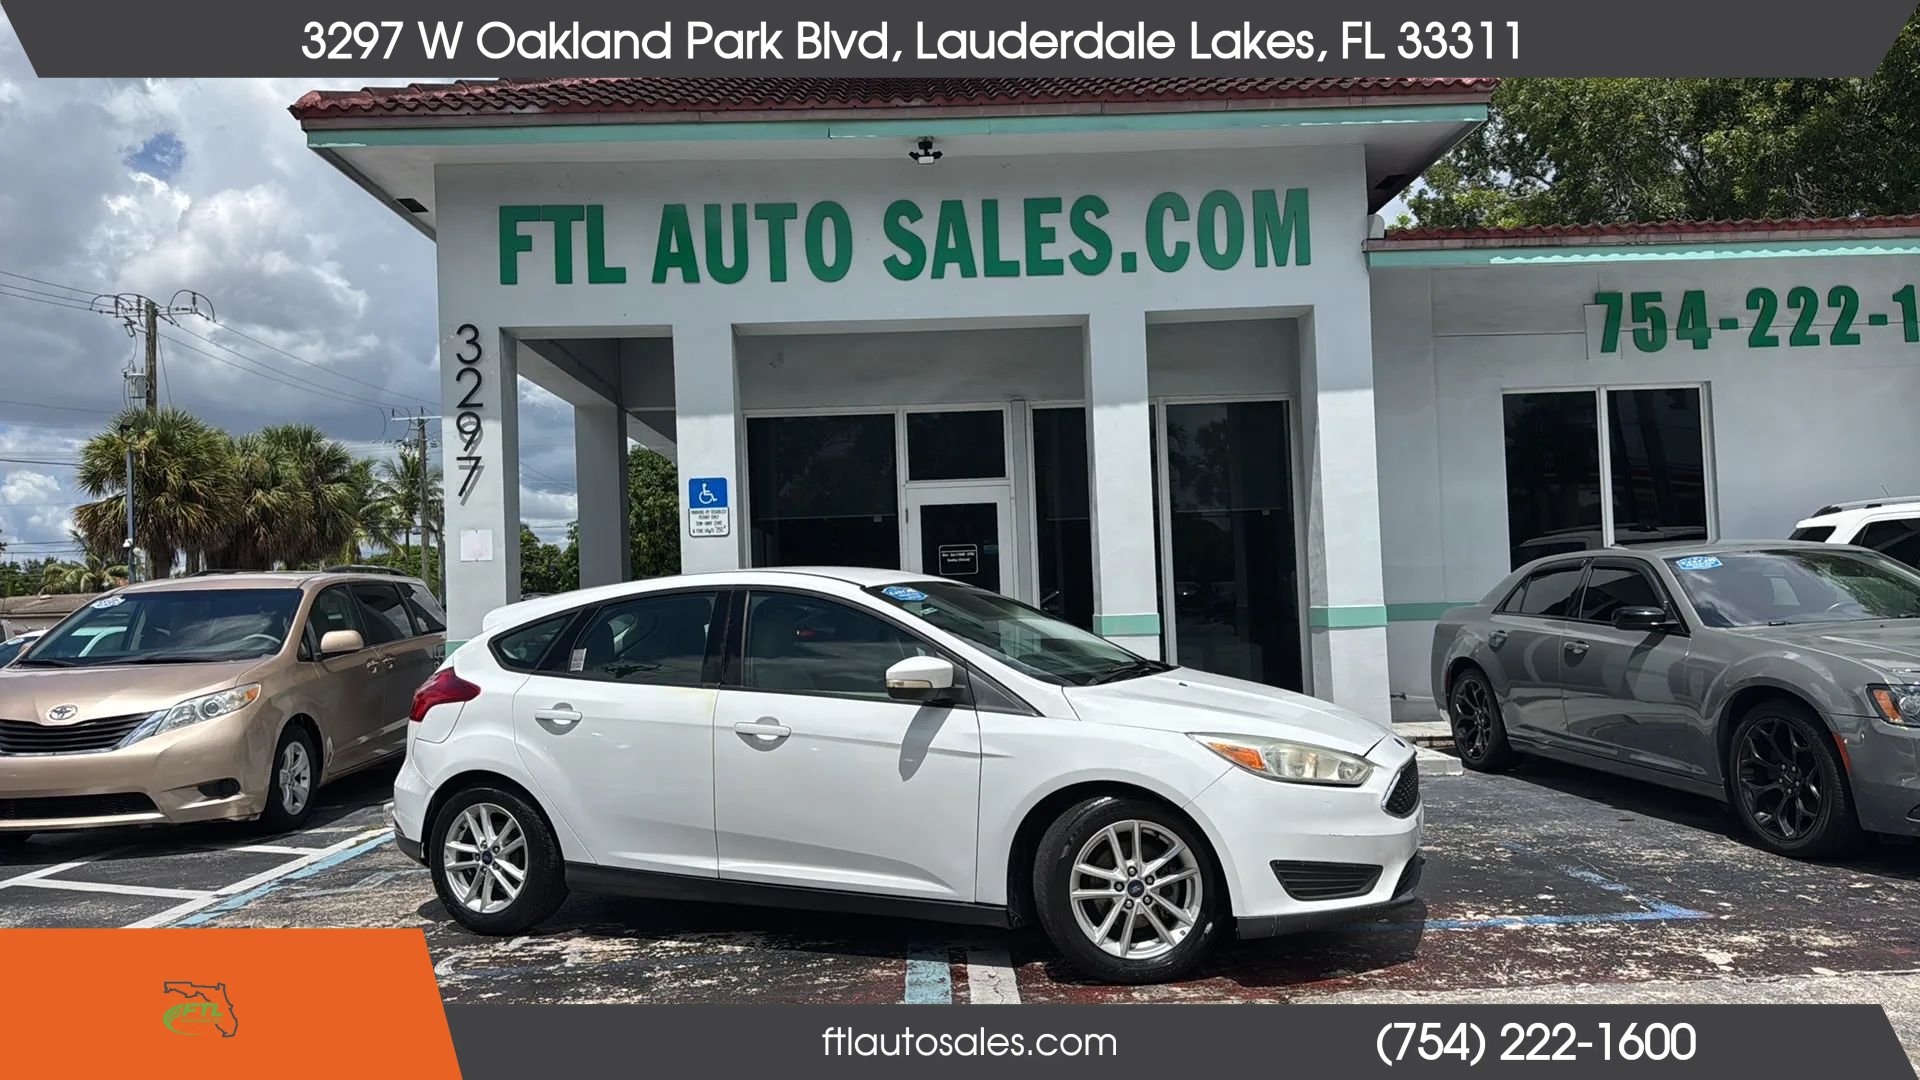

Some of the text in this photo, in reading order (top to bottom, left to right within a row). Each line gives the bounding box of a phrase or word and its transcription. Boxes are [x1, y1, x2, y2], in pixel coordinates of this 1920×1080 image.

[499, 188, 1311, 285] FTL AUTO SALES.COM
[1595, 284, 1920, 354] 754-222-1
[456, 323, 483, 497] 3297
